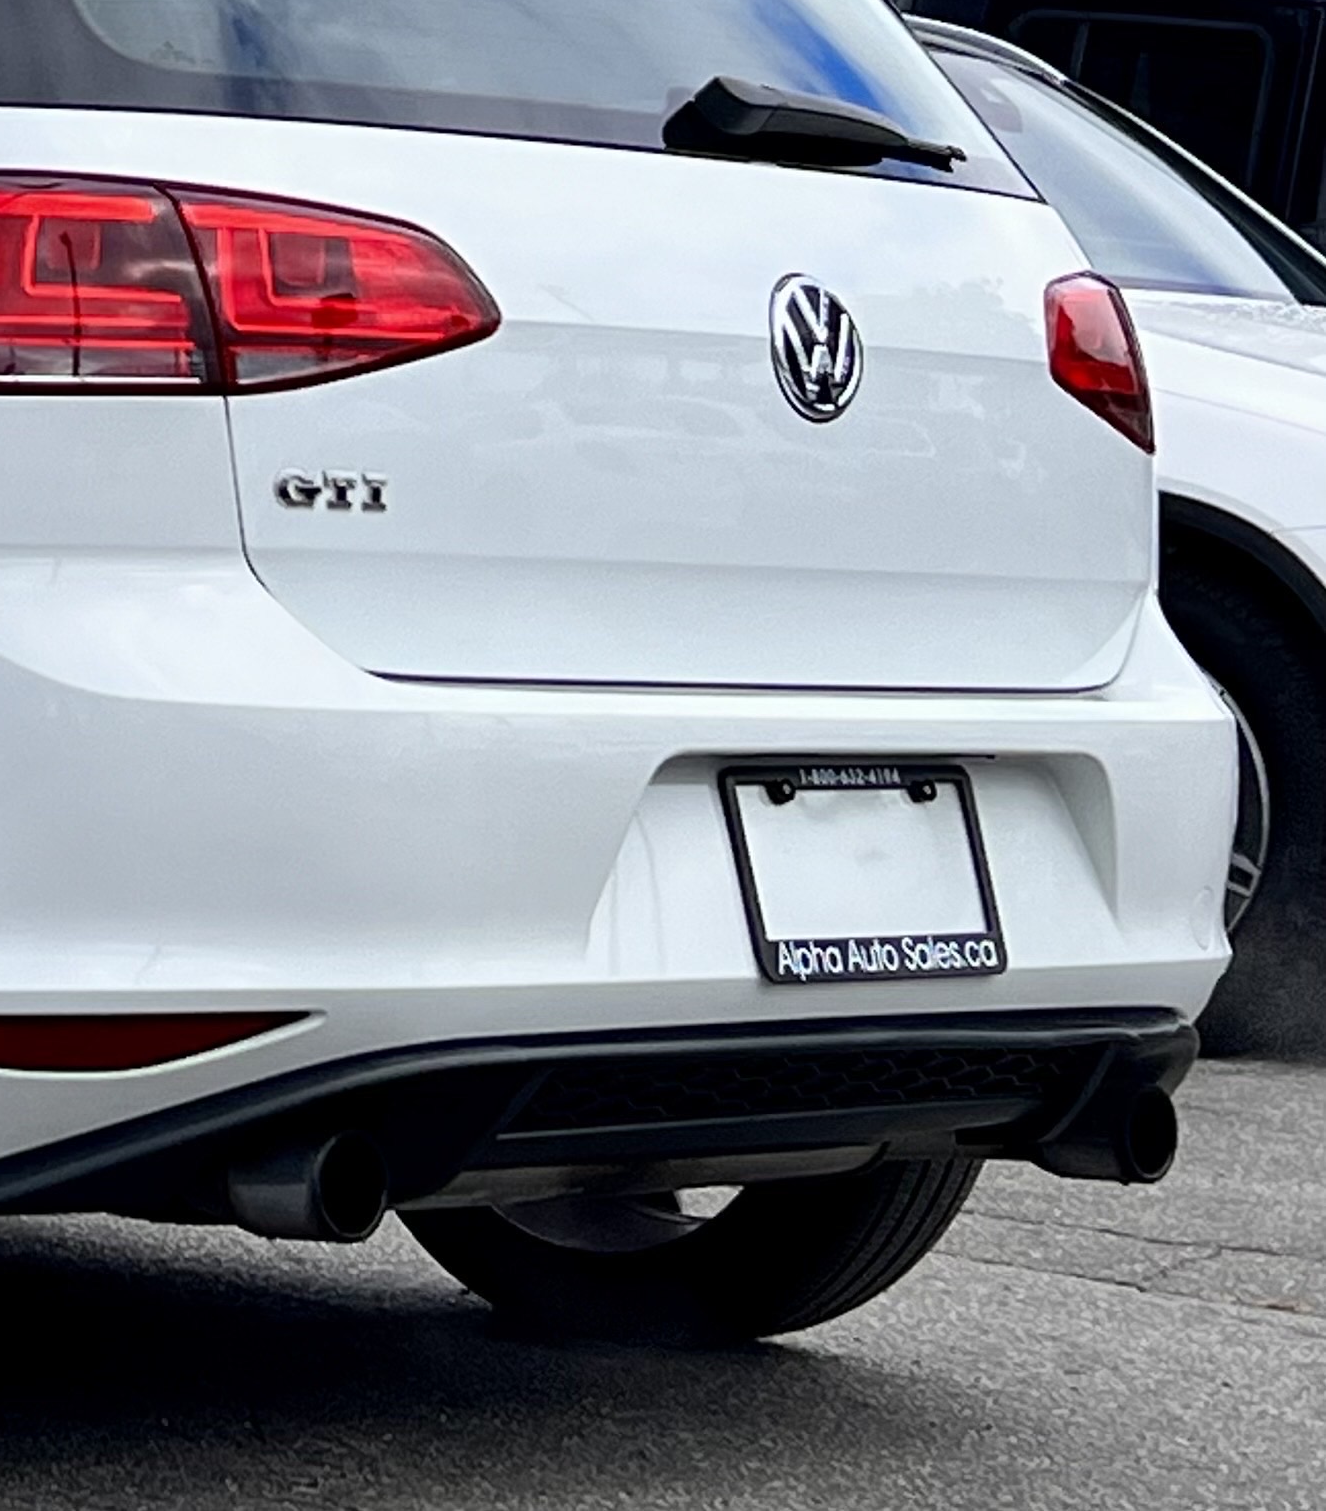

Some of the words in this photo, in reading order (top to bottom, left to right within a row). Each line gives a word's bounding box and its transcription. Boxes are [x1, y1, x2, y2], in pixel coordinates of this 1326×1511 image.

[273, 469, 388, 513] GTI
[778, 940, 844, 981] Alpha
[848, 938, 899, 973] Auto
[901, 936, 999, 972] Sales.ca
